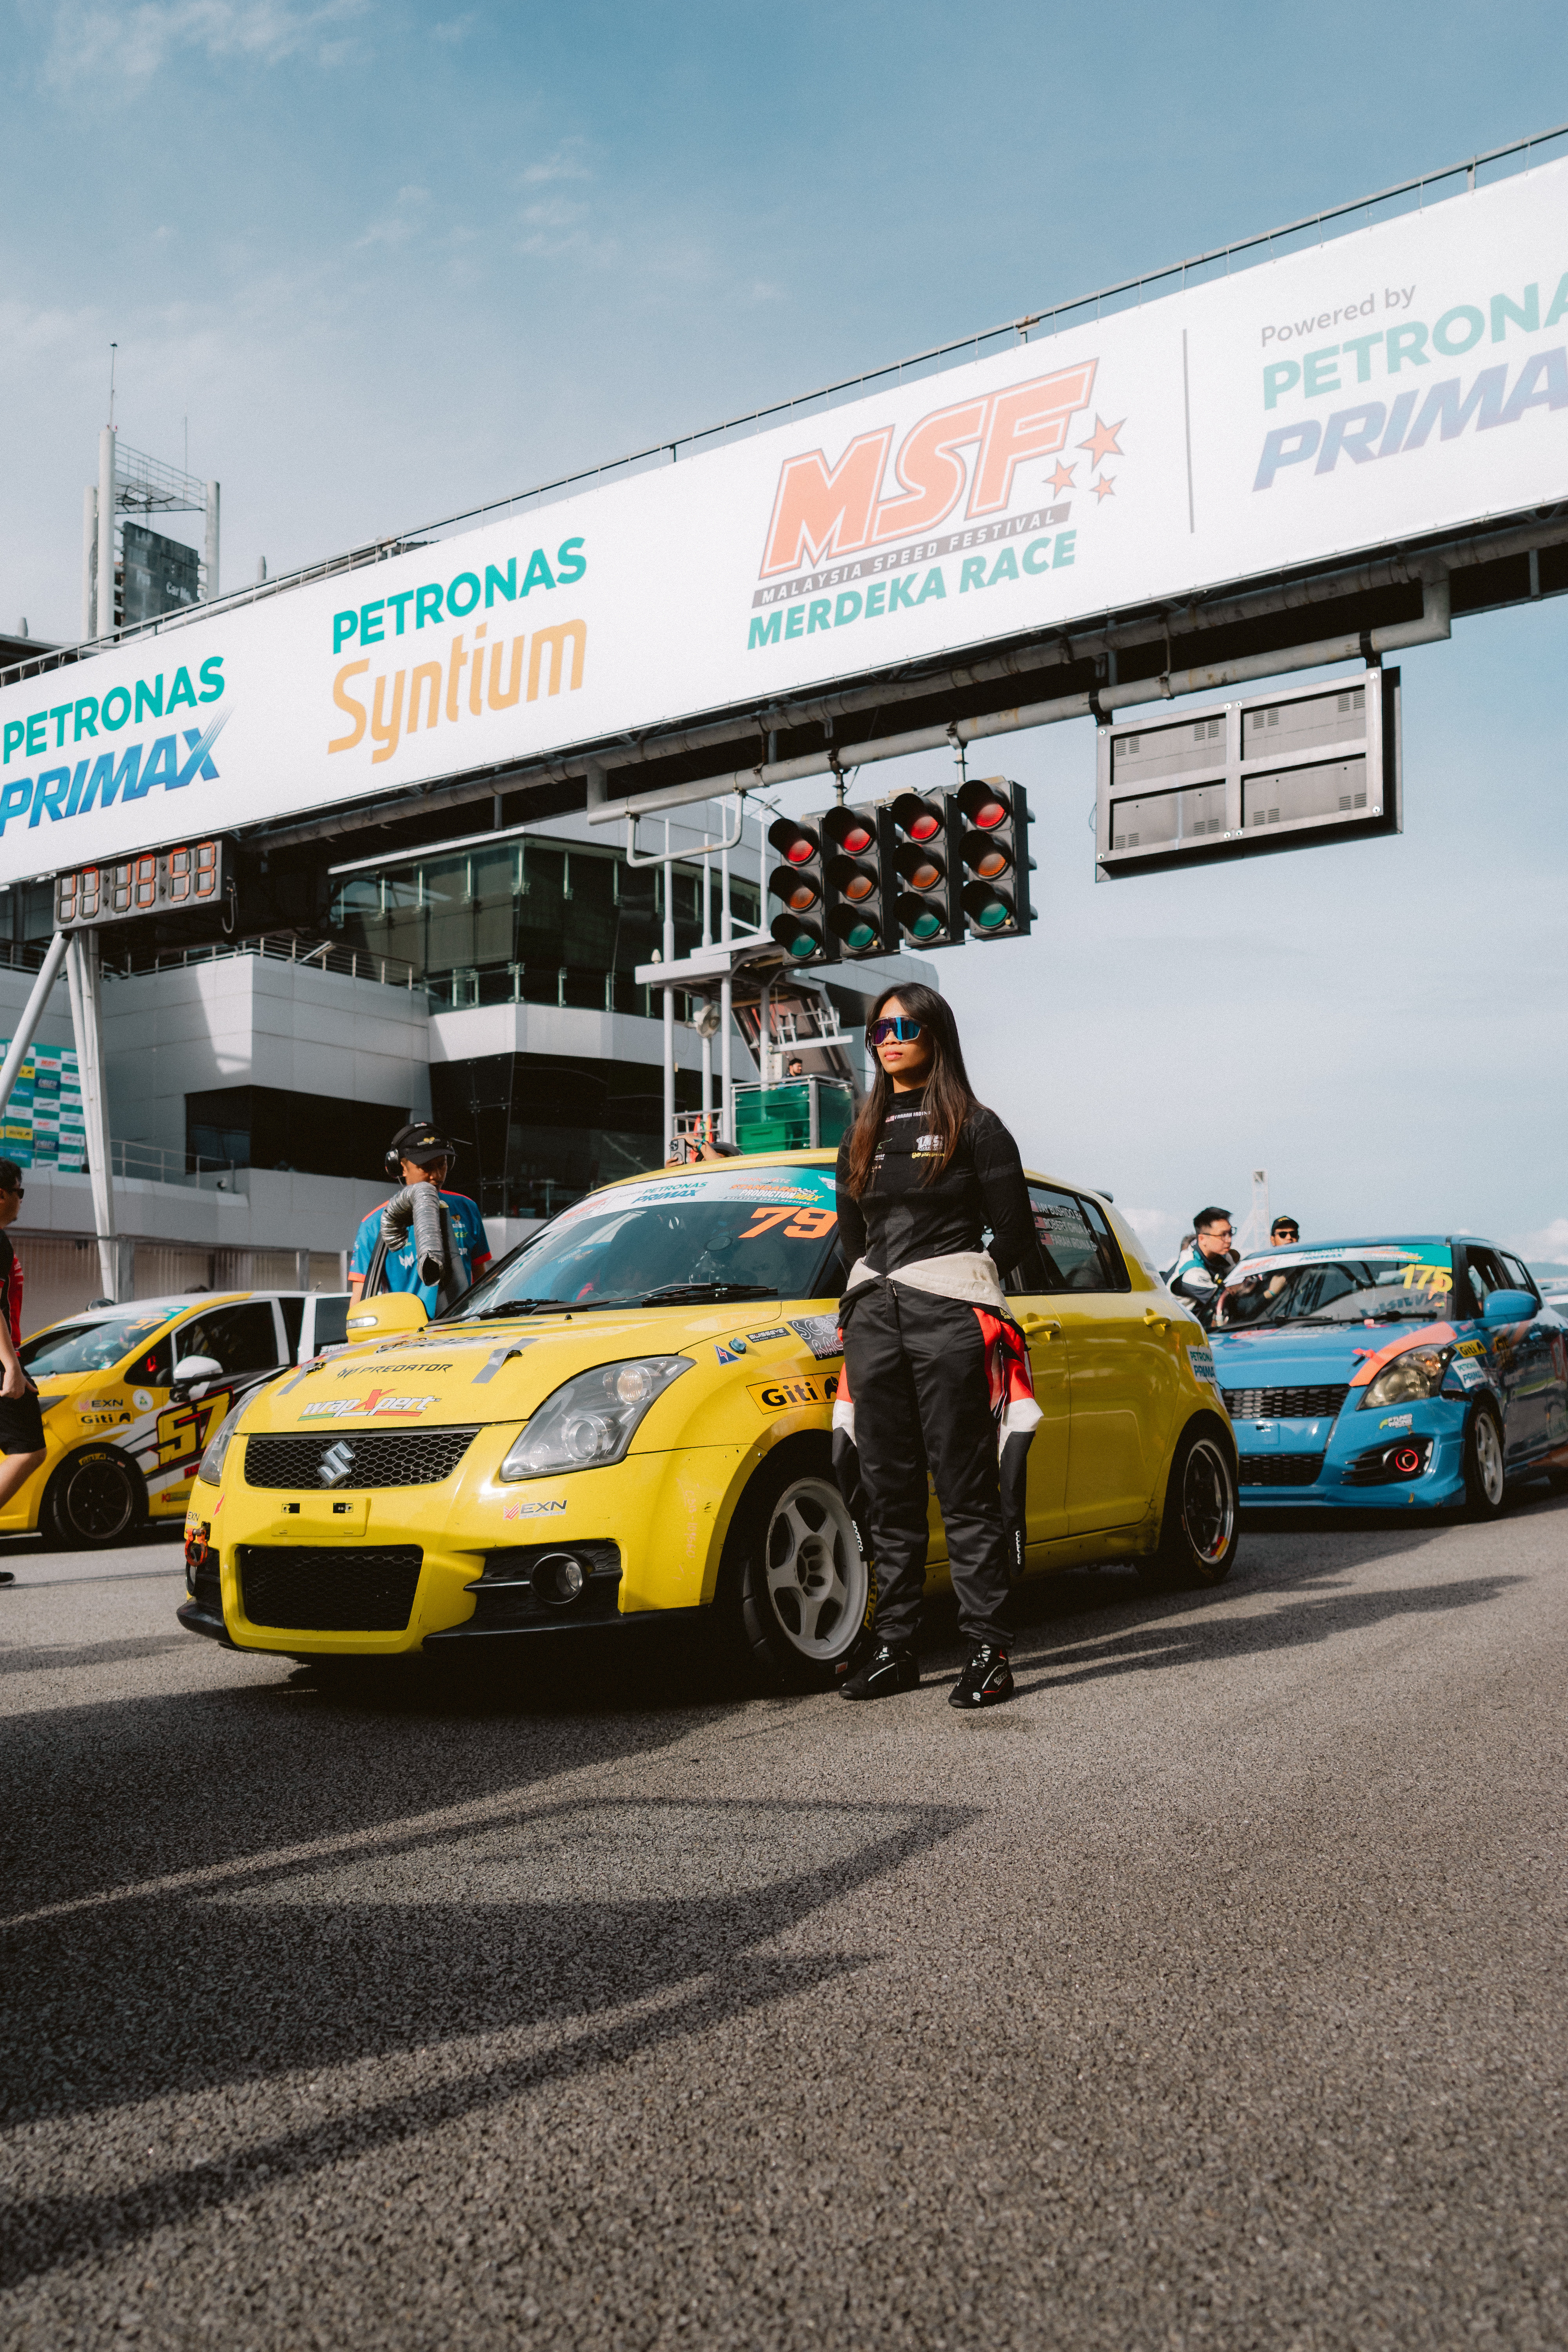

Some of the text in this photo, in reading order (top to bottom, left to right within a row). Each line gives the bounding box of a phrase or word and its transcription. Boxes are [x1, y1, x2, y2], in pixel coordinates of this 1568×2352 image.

[1261, 285, 1417, 348] Powered by
[758, 357, 1100, 581] MSF
[762, 513, 1055, 604] MALAYSIA SPEED FESTIVAL
[333, 537, 587, 655] PETRONAS
[747, 529, 1077, 651] MERDEKA RACE
[328, 619, 587, 764] Syntium
[3, 656, 225, 764] PETRONAS
[0, 719, 225, 837] PRIMAX
[631, 1189, 699, 1204] PRIMAX
[642, 1181, 709, 1195] PETRONAS
[729, 1184, 799, 1192] STANDARD
[739, 1189, 796, 1199] PRODUCTION
[738, 1206, 838, 1239] 79
[1043, 1218, 1067, 1231] ROBERT
[1399, 1264, 1453, 1293] 175
[1459, 1344, 1477, 1356] Giti
[358, 1364, 453, 1374] PREDATOR
[91, 1399, 123, 1408] EXN
[761, 1381, 819, 1407] Giti
[81, 1414, 113, 1424] Giti
[157, 1392, 230, 1465] 57
[187, 1511, 200, 1521] EXN
[521, 1500, 567, 1514] EXN
